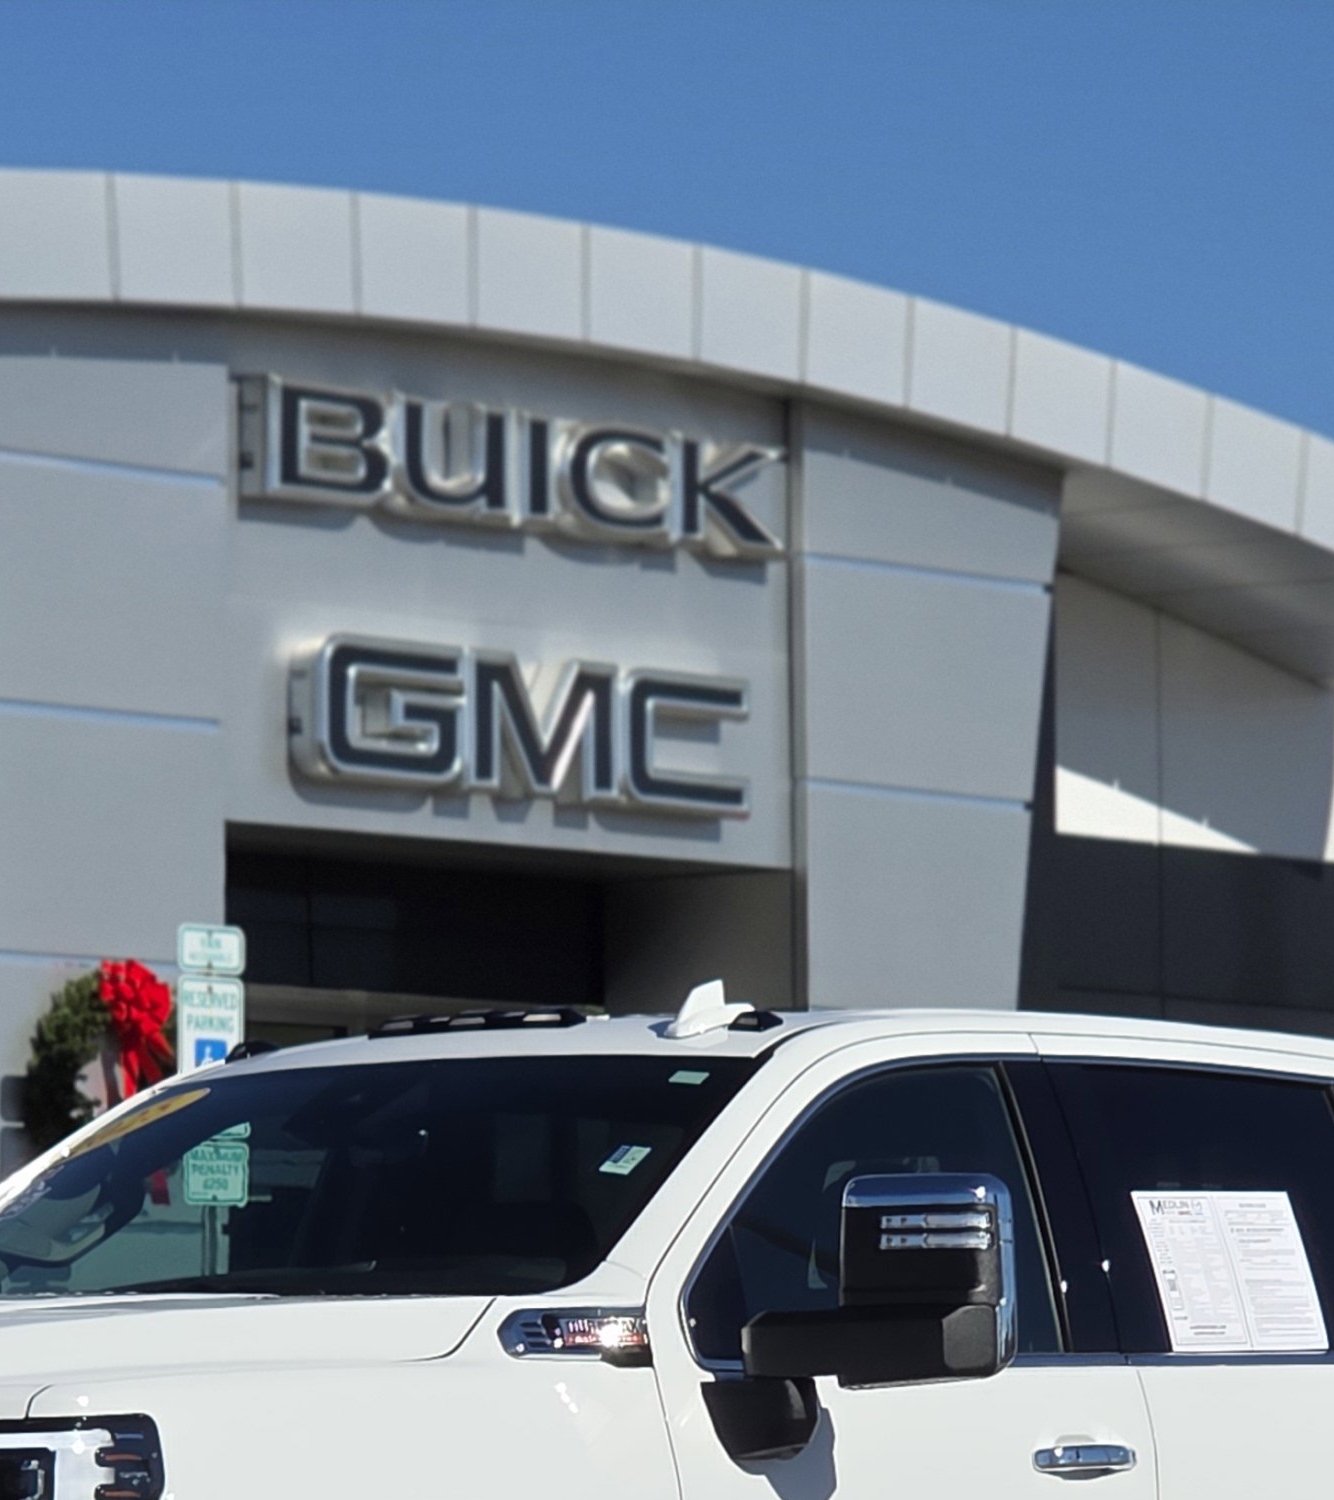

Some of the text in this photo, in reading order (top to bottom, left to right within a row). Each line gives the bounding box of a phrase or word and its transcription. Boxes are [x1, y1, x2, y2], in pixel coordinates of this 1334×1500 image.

[265, 372, 789, 562] BUICK
[313, 632, 750, 820] GMC
[183, 990, 238, 1011] RESERVED
[186, 1013, 235, 1034] PARKING
[191, 1163, 240, 1177] PENALTY
